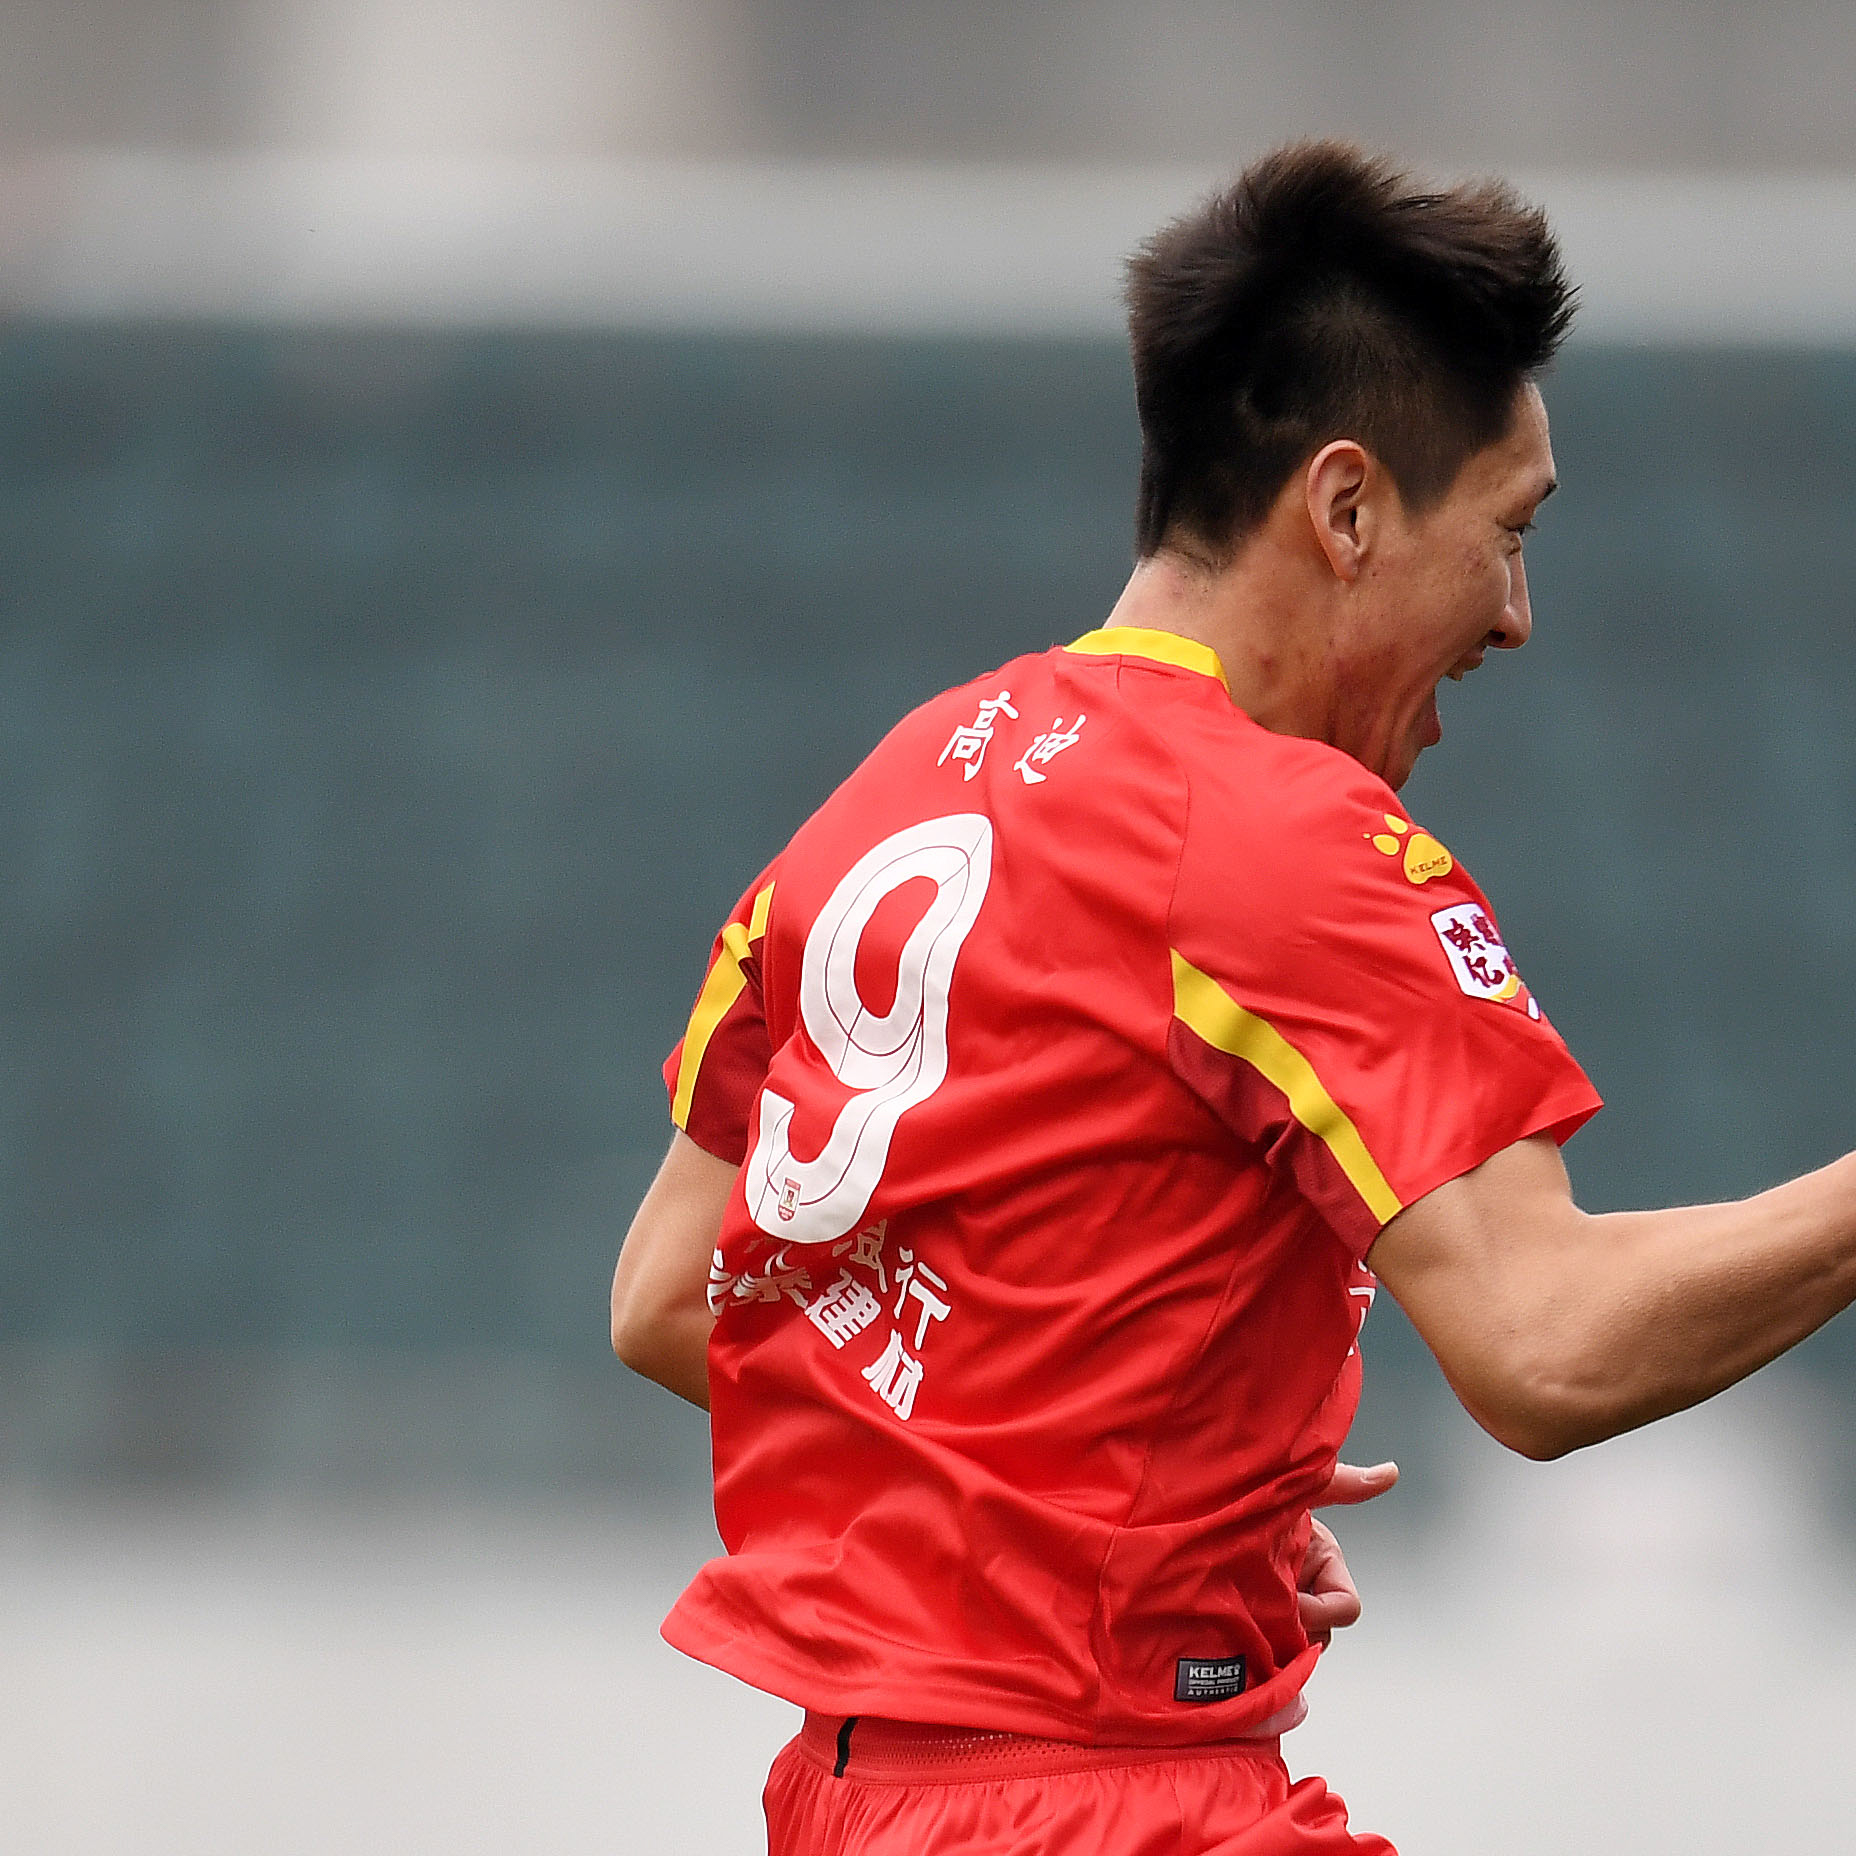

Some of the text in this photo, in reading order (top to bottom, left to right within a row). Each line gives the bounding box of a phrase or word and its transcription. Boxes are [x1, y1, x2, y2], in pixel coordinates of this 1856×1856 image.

[937, 690, 1086, 785] 高迪
[1409, 856, 1448, 875] KELME
[746, 813, 993, 1244] 9
[1189, 1665, 1233, 1679] KELME
